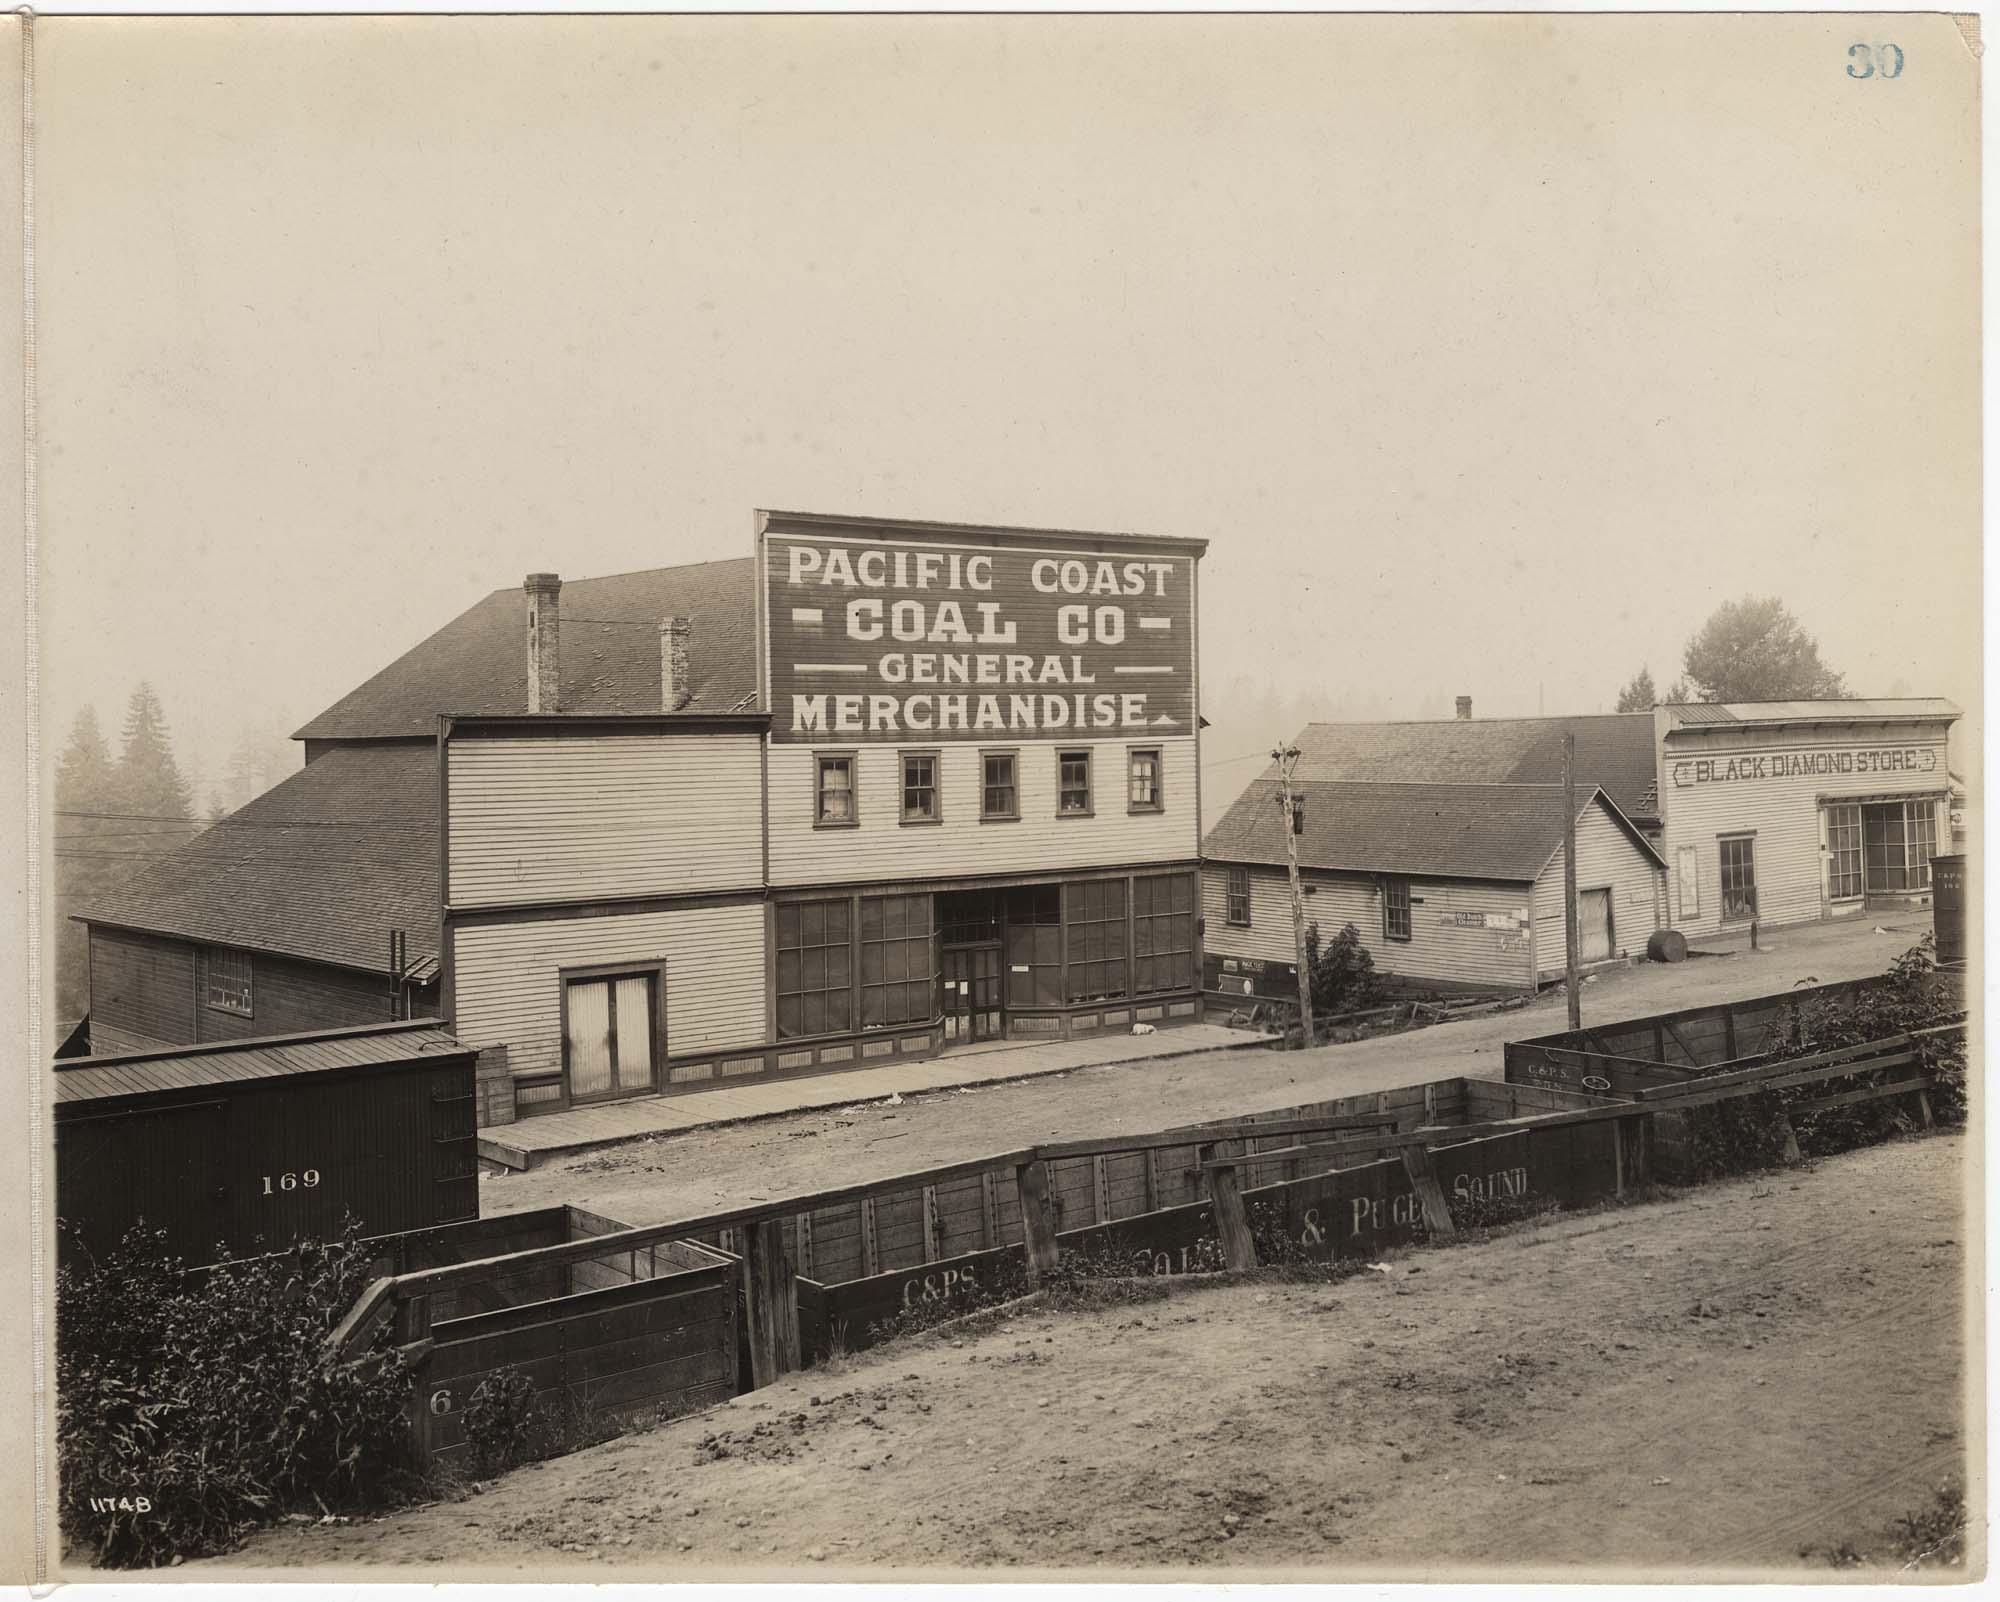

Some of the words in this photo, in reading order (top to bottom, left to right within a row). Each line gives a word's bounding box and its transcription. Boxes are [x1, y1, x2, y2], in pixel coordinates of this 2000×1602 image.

[1847, 44, 1904, 78] 30
[787, 546, 993, 591] PACIFIC
[1031, 559, 1174, 596] COAST
[847, 598, 1017, 643] COAL
[1057, 604, 1125, 645] CO
[879, 653, 1095, 684] GENERAL
[791, 693, 1148, 731] MERCHANDISE
[1695, 760, 1768, 783] BLACK
[1772, 754, 1853, 777] DIAMOND
[262, 1169, 320, 1195] 169
[1302, 1208, 1326, 1247] &
[1351, 1192, 1424, 1236] PUGE
